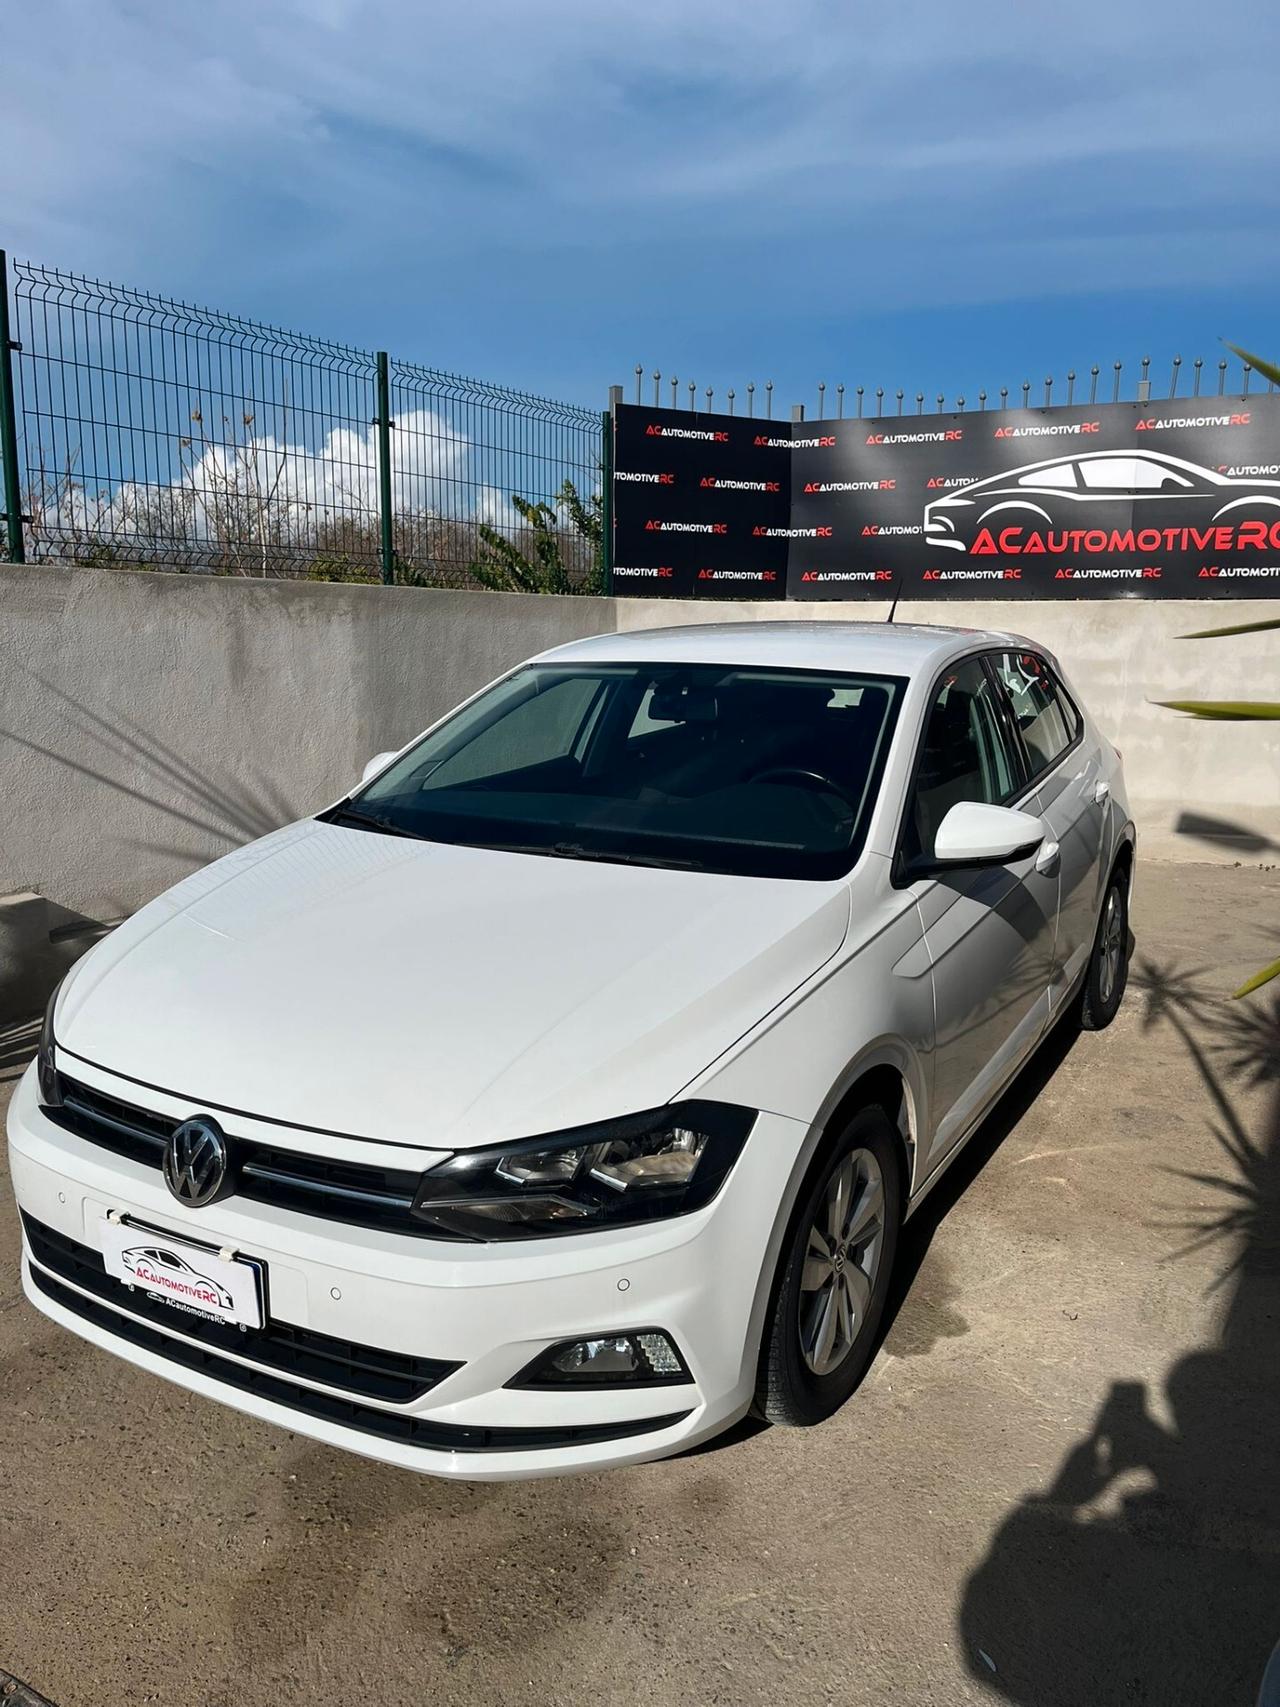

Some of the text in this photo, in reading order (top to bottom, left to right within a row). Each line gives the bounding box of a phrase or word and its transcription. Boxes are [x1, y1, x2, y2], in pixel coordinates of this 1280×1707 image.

[1135, 413, 1251, 431] ACAUTOMOTIVERC
[645, 424, 729, 442] ACAUTOMOTIVERC
[994, 422, 1100, 438] ACAUTOMOTIVERC
[753, 435, 836, 449] ACAUTOMOTIVERC
[865, 430, 963, 446] ACAUTOMOTIVERC
[700, 477, 780, 492] ACAUTOMOTIVERC
[804, 479, 896, 493] ACAUTOMOTIVERC
[645, 519, 728, 534] ACAUTOMOTIVERC
[752, 526, 833, 537] ACAUTOMOTIVERC
[698, 568, 776, 581] ACAUTOMOTIVERC
[801, 570, 893, 582] ACAUTOMOTIVERC
[922, 568, 1022, 581] ACAUTOMOTIVERC
[1055, 567, 1162, 580] ACAUTOMOTIVERC
[165, 1297, 226, 1325] ACautomotiveRC
